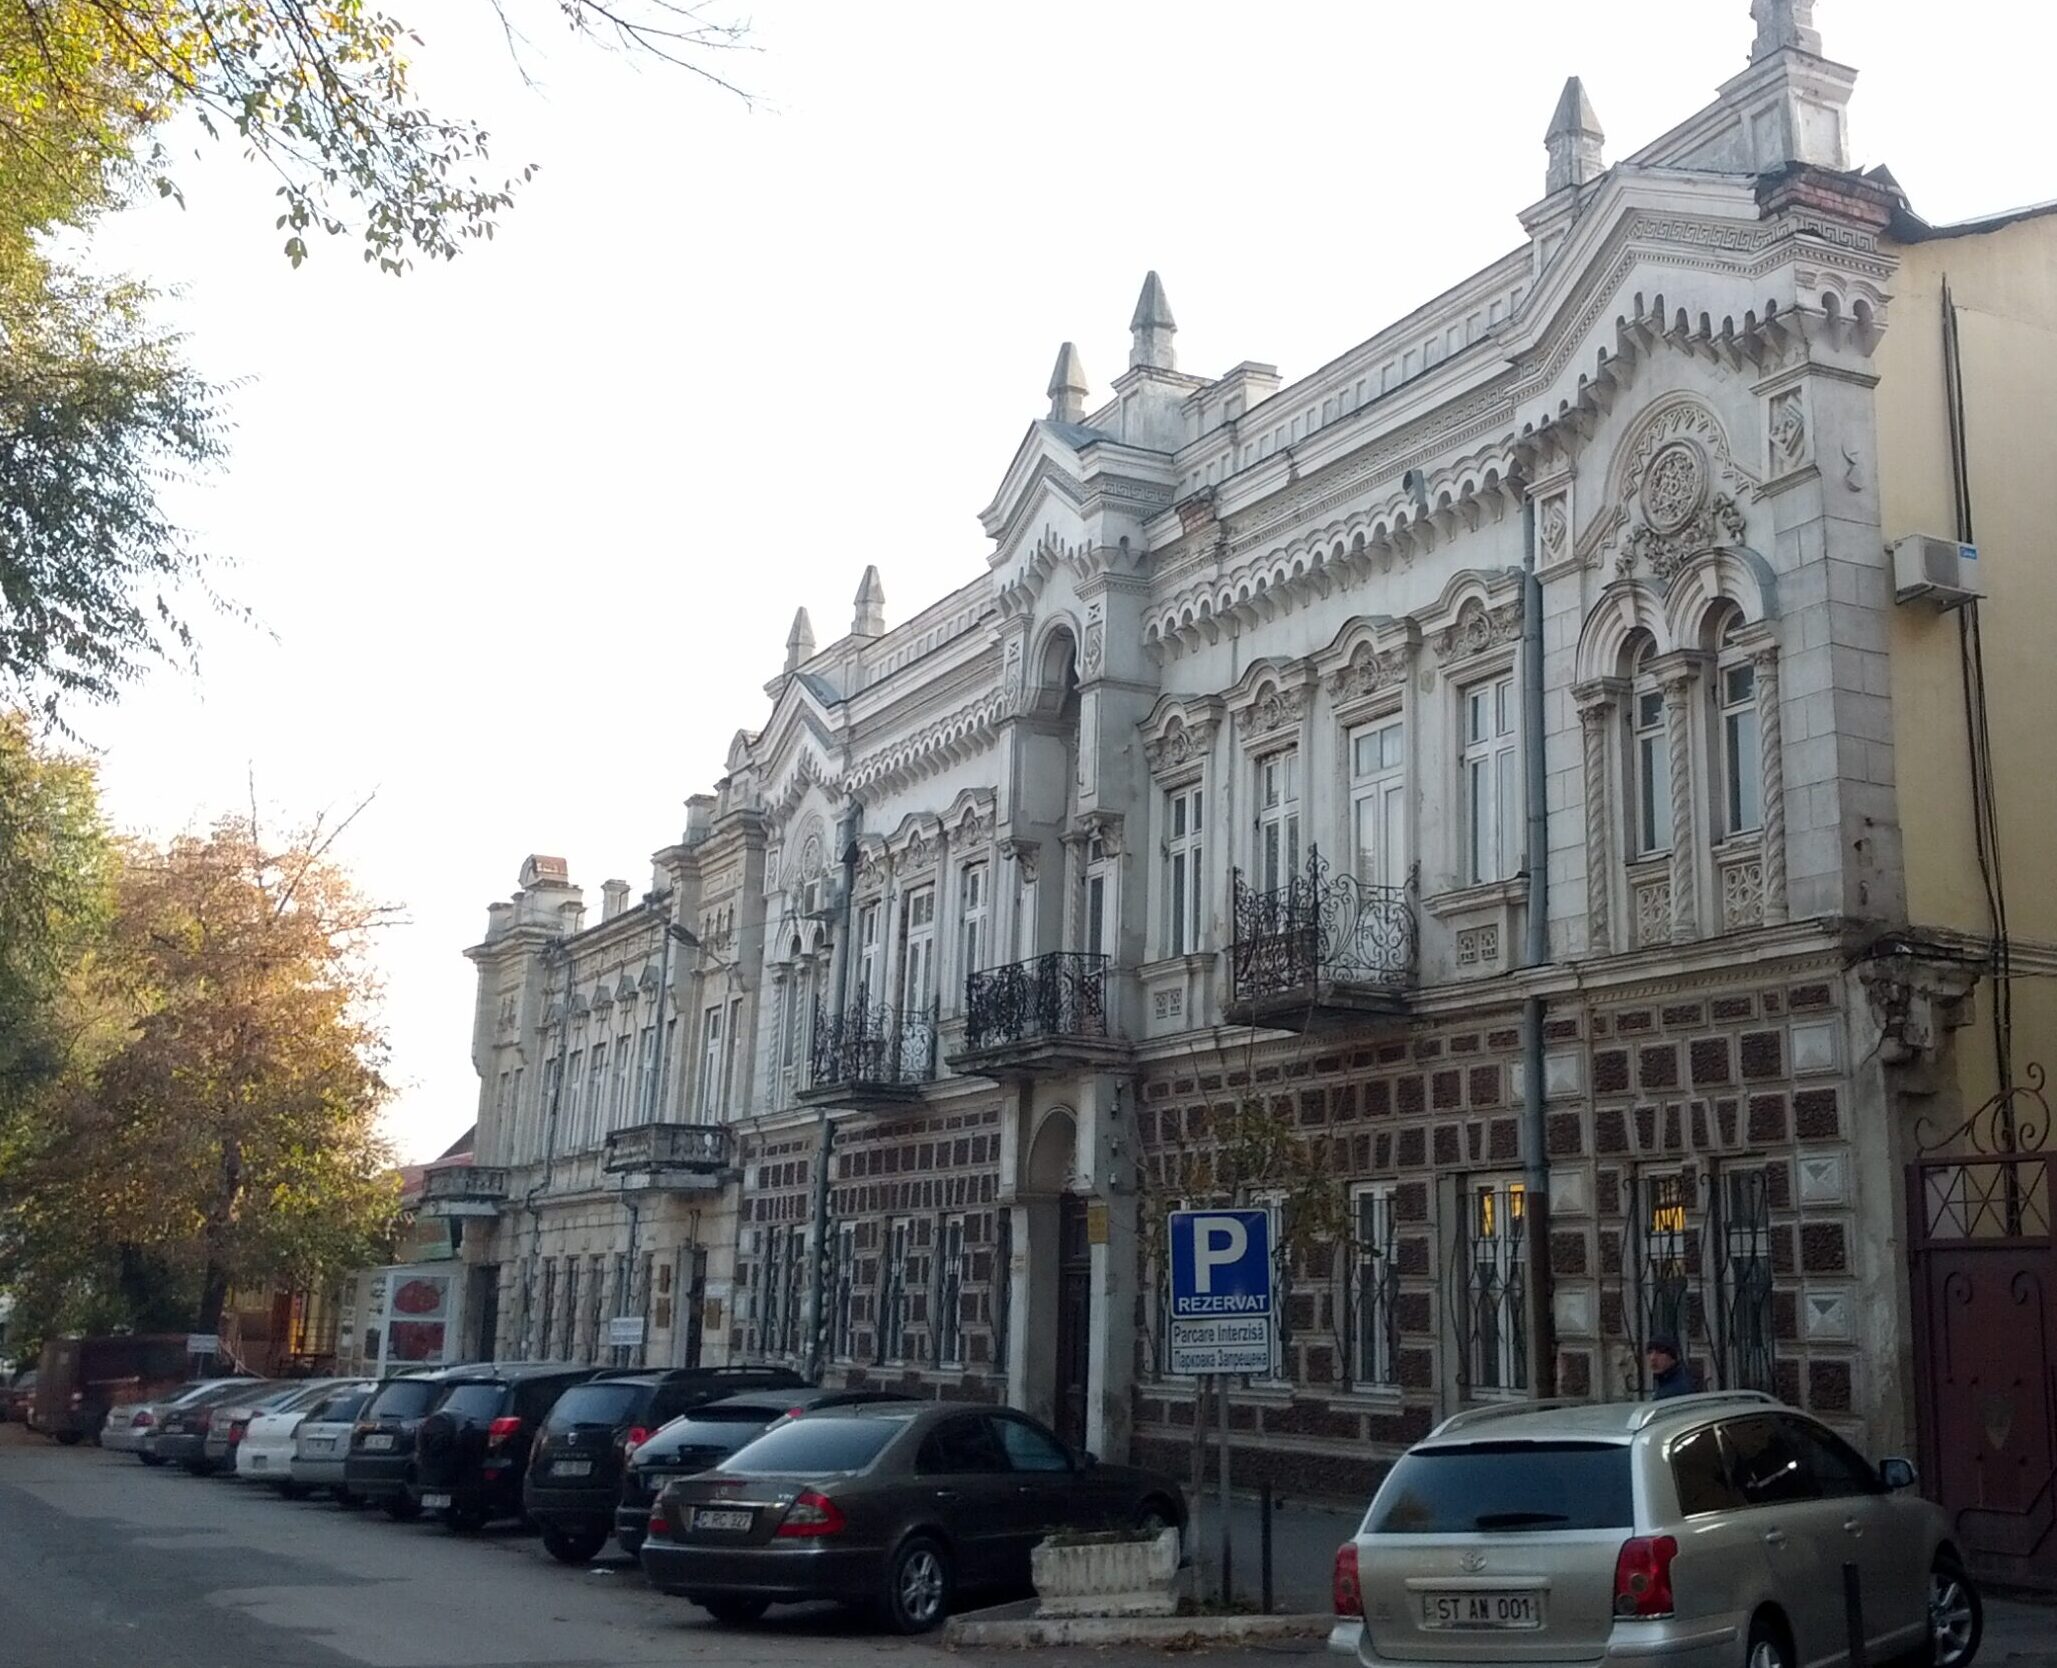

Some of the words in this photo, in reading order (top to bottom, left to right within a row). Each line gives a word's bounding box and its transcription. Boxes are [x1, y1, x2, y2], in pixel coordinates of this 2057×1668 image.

[1193, 1217, 1248, 1294] P
[1179, 1295, 1266, 1312] REZERVAT
[1174, 1325, 1215, 1343] Parcare
[1437, 1599, 1460, 1619] ST
[1498, 1599, 1530, 1619] 001
